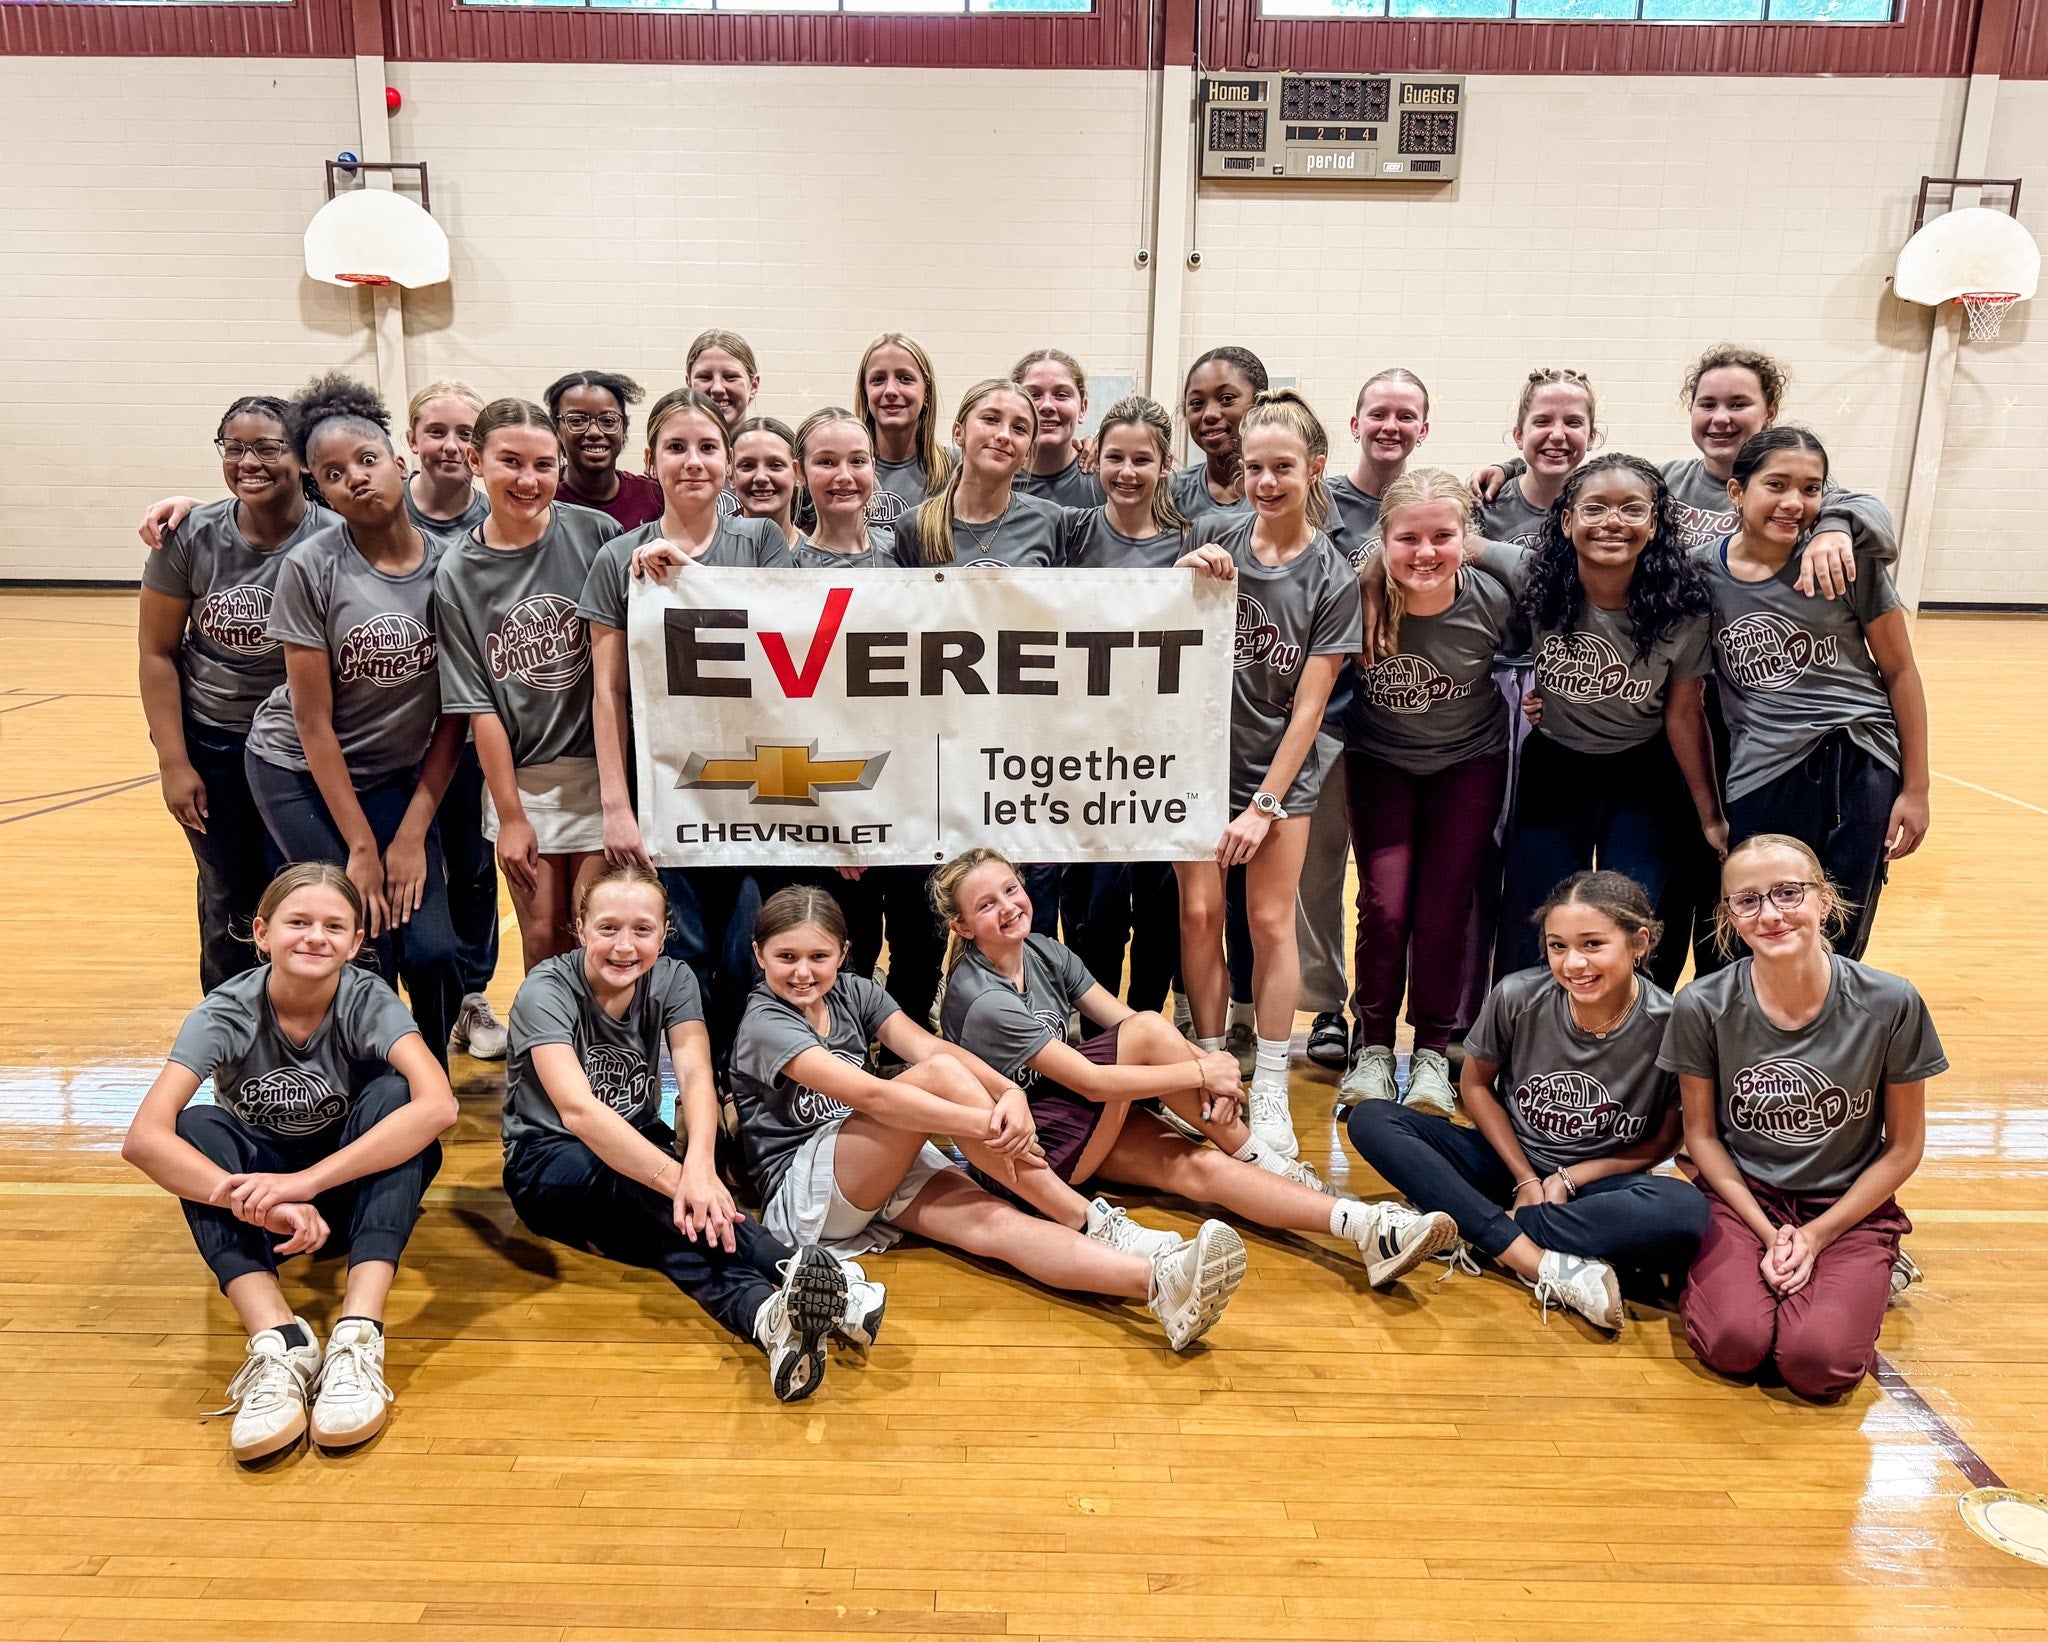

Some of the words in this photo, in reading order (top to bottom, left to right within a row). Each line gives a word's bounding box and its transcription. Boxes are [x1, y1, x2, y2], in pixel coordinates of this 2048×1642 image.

[1209, 81, 1250, 101] Home
[1403, 84, 1455, 104] Guests
[1295, 127, 1299, 140] 1
[1317, 127, 1325, 140] 2
[1339, 128, 1347, 141] 3
[1362, 128, 1371, 141] 4
[1307, 152, 1355, 173] period
[502, 614, 556, 650] Benton
[664, 587, 1204, 698] EVERETT
[1249, 623, 1301, 675] Day
[1719, 625, 1775, 651] Benton
[1783, 630, 1838, 668] Day
[338, 643, 409, 682] Game
[485, 633, 559, 681] Game
[1599, 662, 1652, 704] Day
[980, 747, 1175, 787] Together
[677, 823, 893, 844] CHEVROLET
[241, 1077, 308, 1105] Benton
[1527, 1074, 1582, 1105] Benton
[1733, 1067, 1804, 1096] Benton
[1515, 1085, 1583, 1137] Game
[1590, 1100, 1647, 1143] Day
[1729, 1093, 1809, 1132] Game
